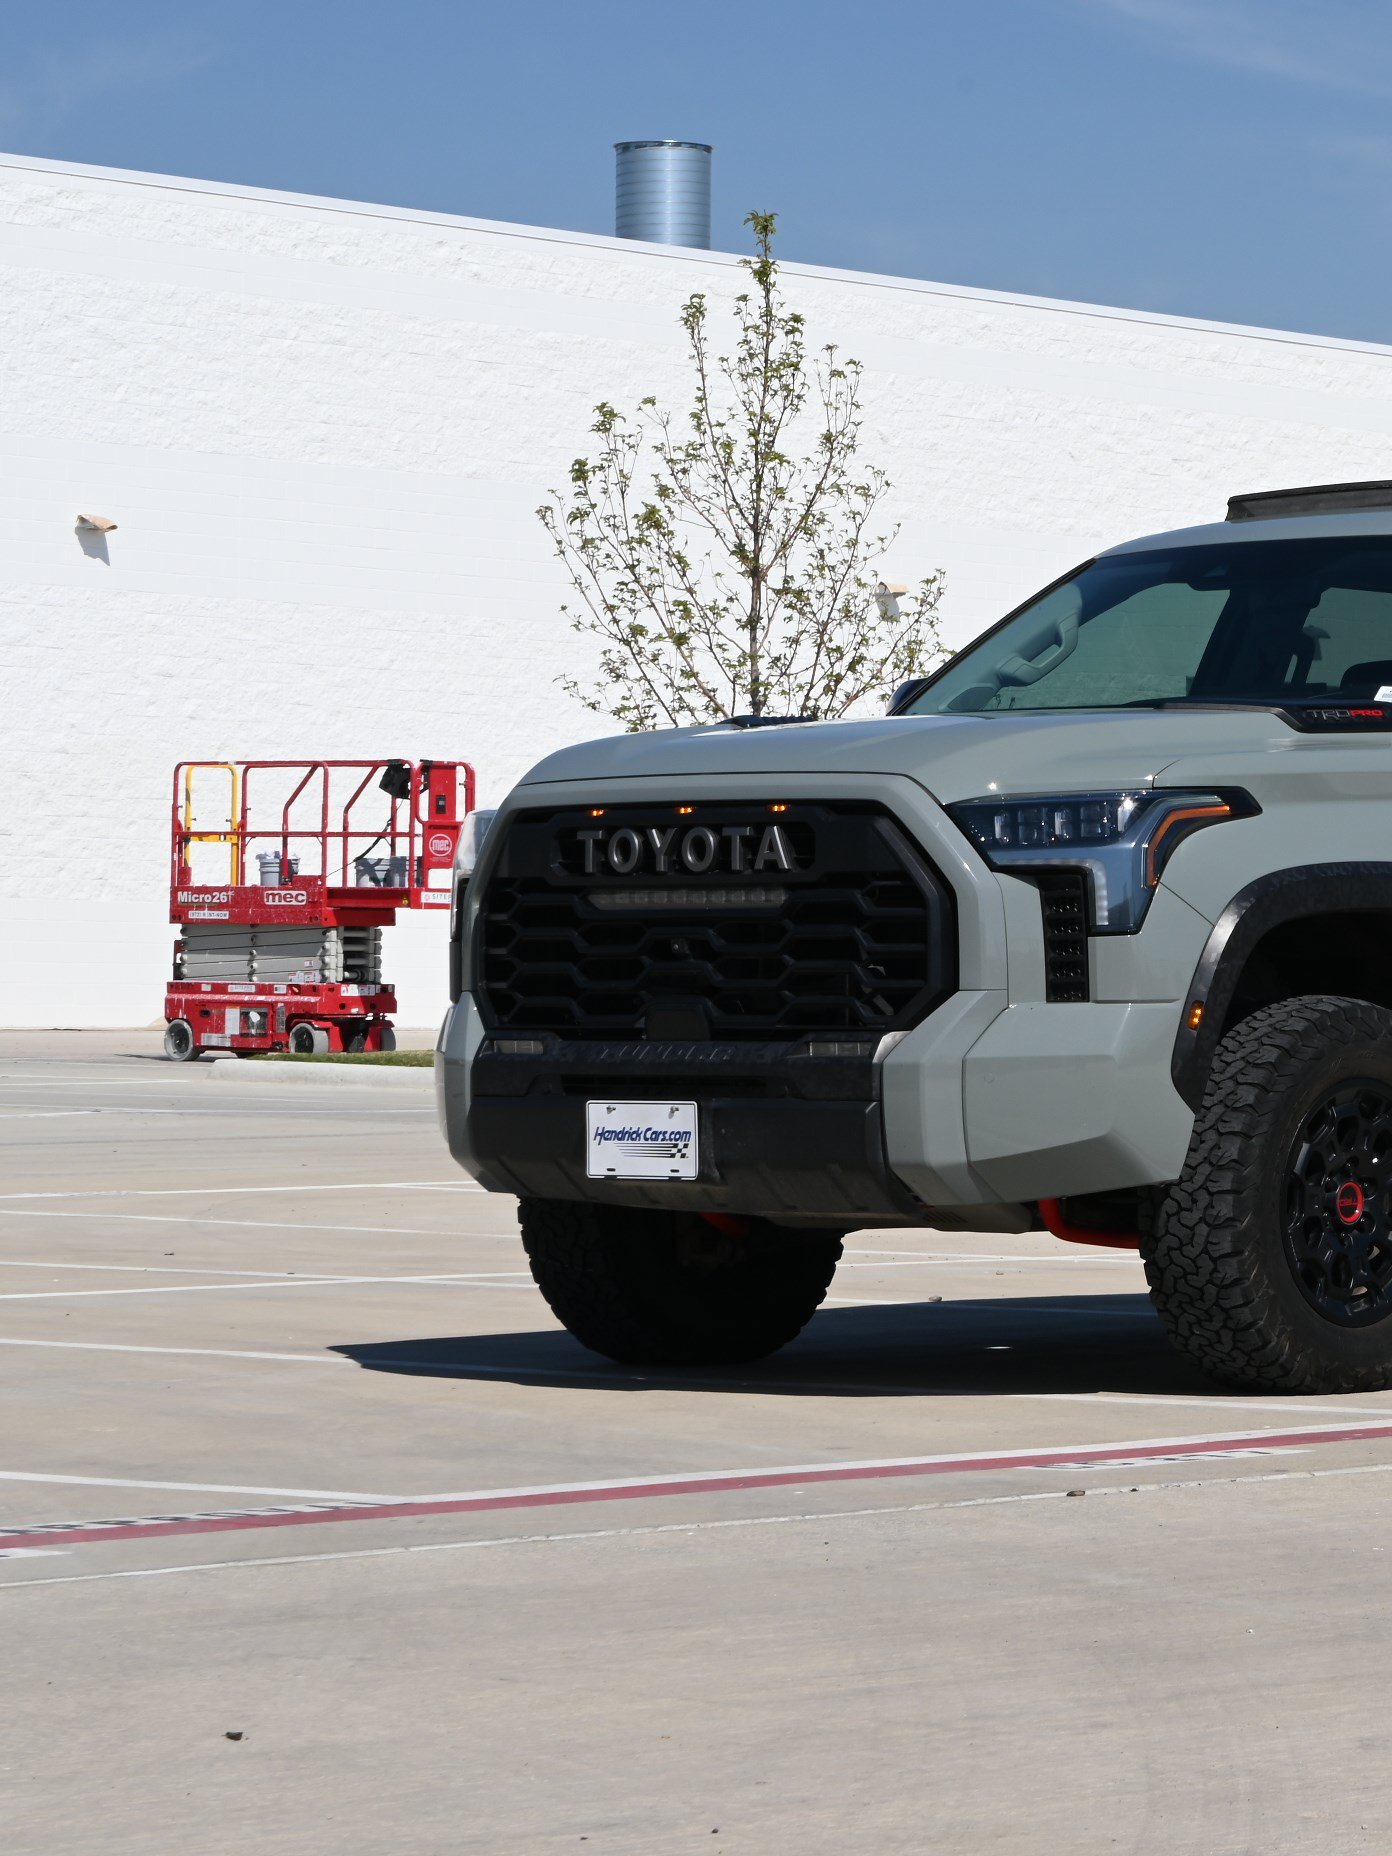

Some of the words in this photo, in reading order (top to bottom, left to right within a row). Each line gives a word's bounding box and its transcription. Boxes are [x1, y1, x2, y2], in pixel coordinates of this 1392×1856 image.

[1350, 709, 1384, 717] PRO
[577, 825, 794, 873] TOYOTA
[177, 890, 228, 903] Micro26
[265, 891, 306, 903] mec
[593, 1126, 643, 1145] Hendrick
[643, 1127, 692, 1142] Cars.com
